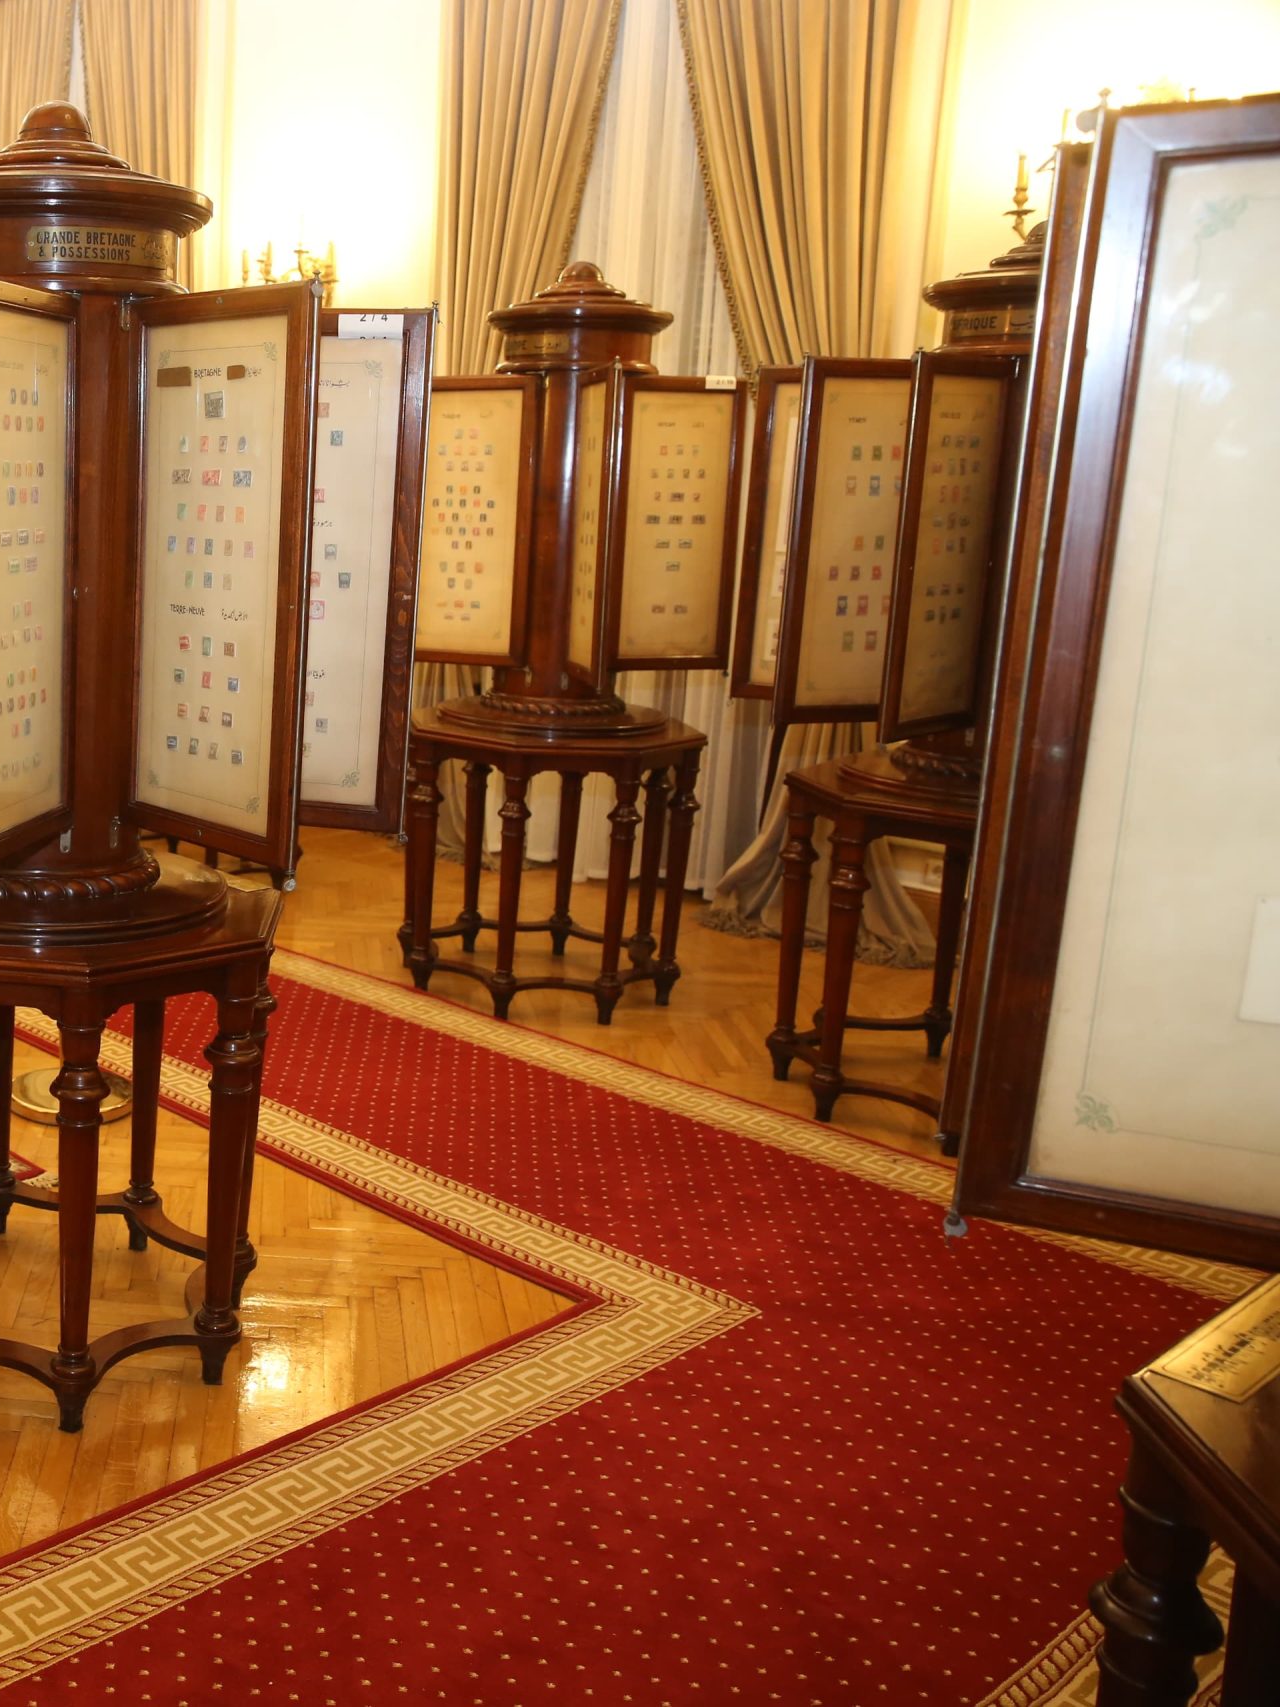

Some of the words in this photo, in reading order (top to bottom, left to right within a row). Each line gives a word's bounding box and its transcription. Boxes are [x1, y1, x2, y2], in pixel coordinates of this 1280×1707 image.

[36, 231, 80, 245] GRANDE
[86, 232, 137, 248] BRETAGNE
[51, 246, 131, 261] POSSESSIONS
[193, 367, 222, 380] BRETAGNE
